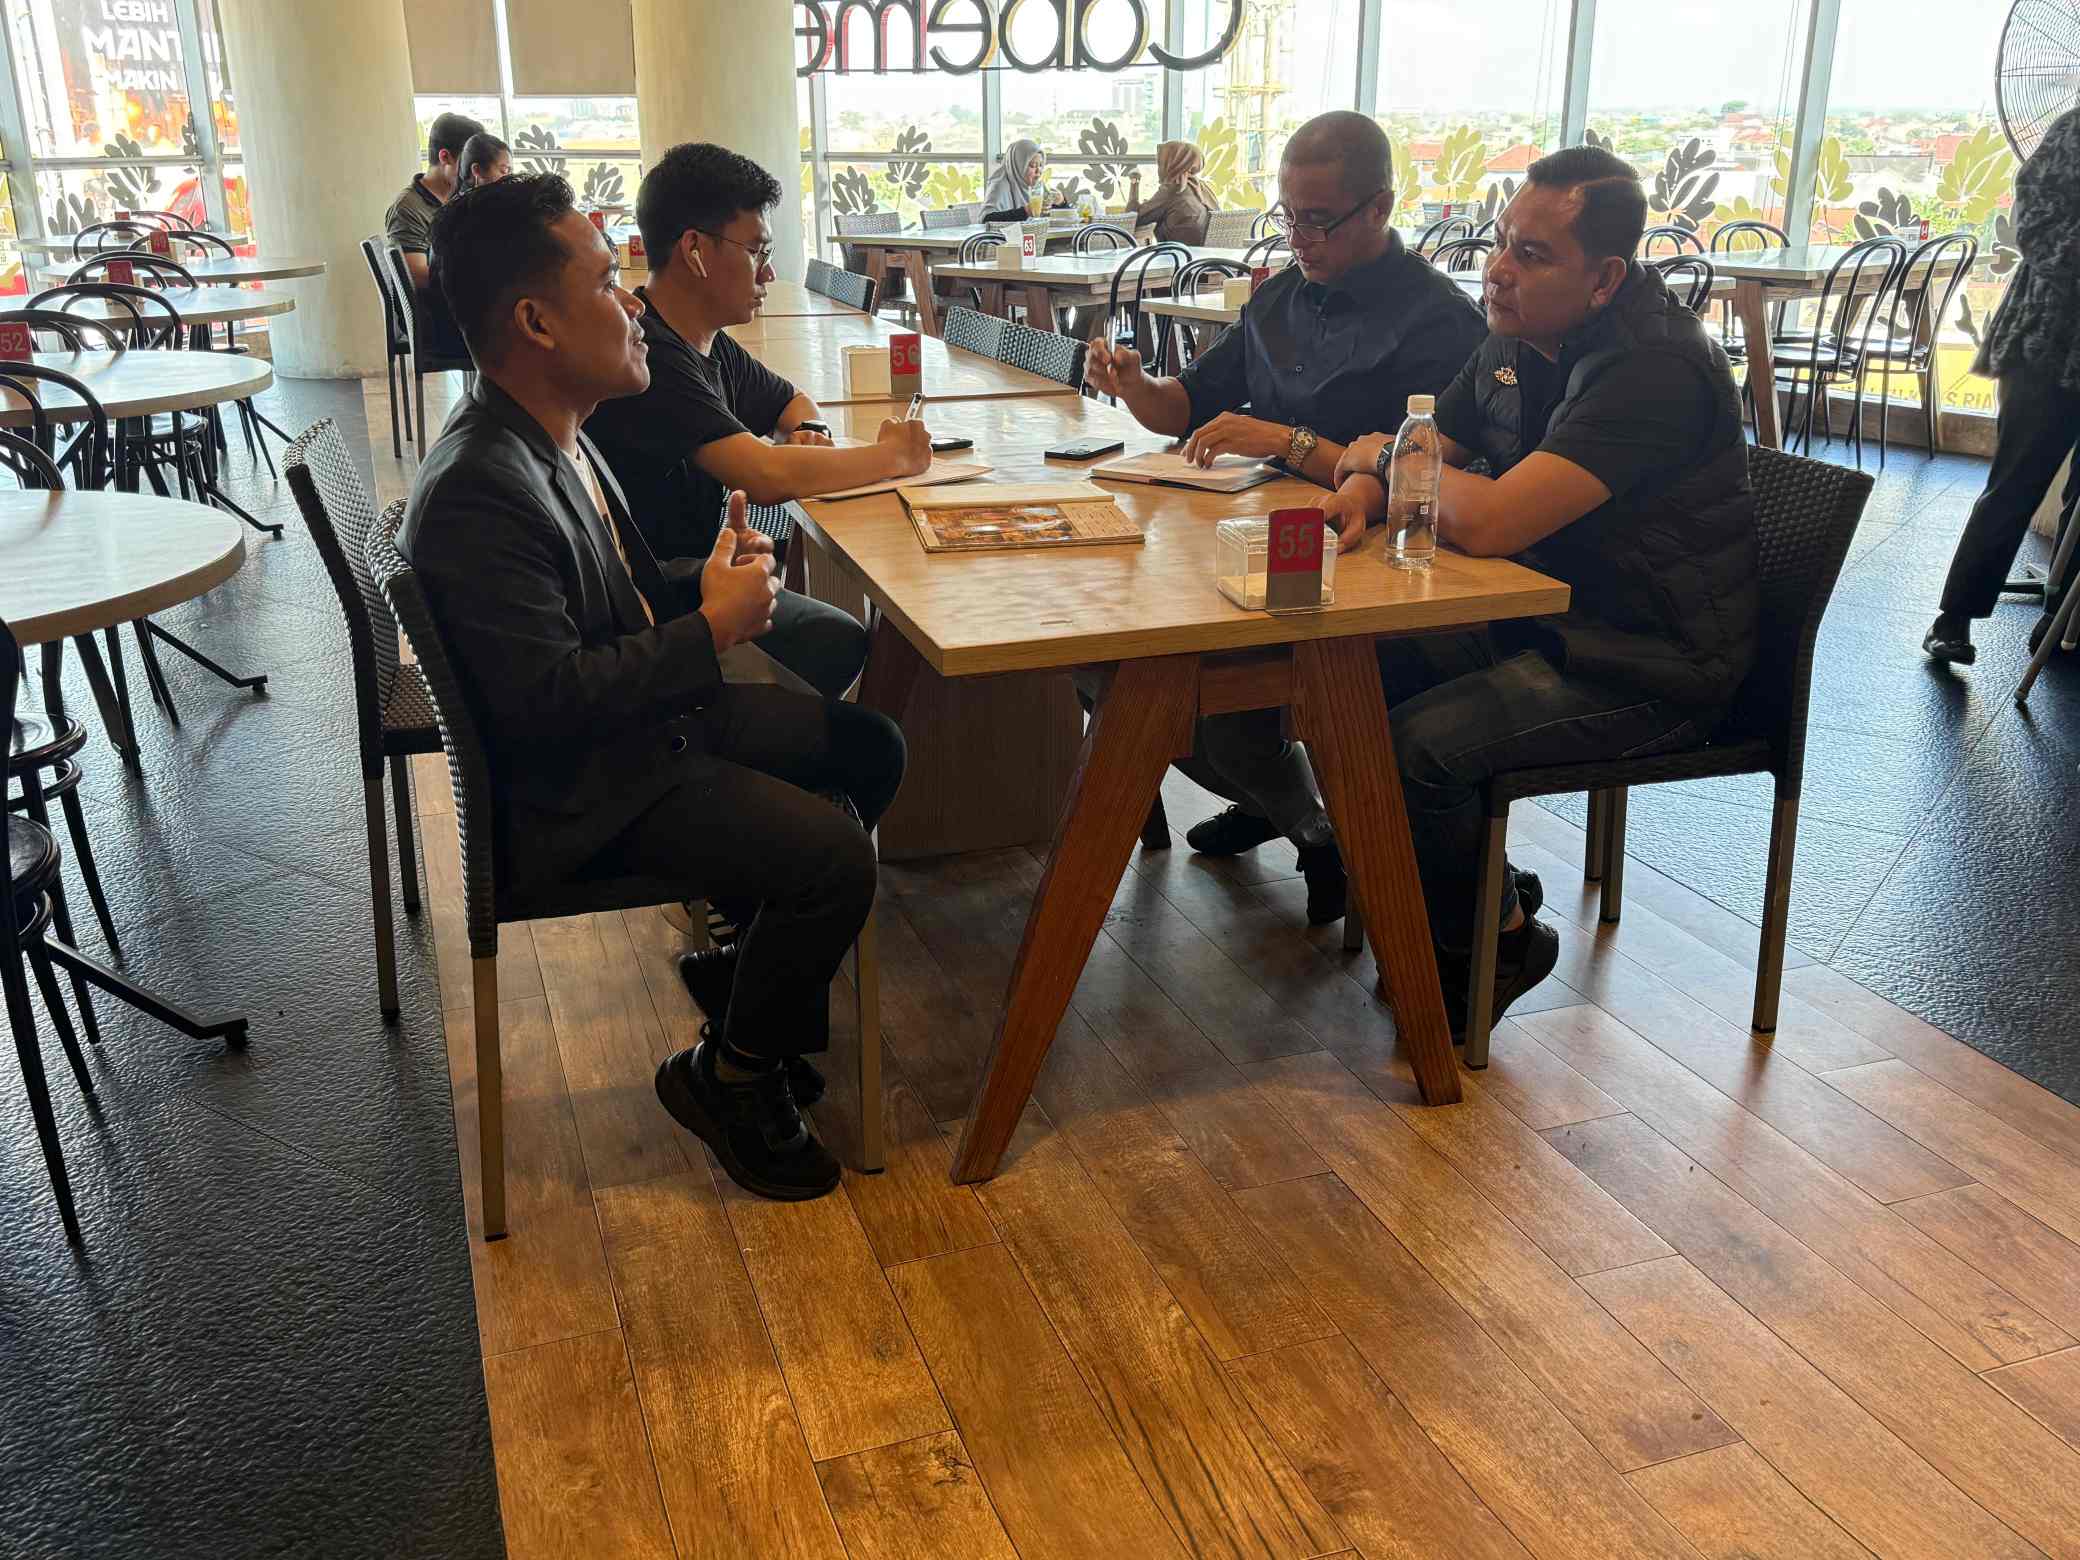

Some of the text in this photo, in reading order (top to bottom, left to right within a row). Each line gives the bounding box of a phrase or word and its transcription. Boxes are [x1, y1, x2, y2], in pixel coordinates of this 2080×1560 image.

[101, 0, 169, 23] LEBIH
[1024, 239, 1033, 252] 63
[0, 332, 23, 352] 52
[1279, 523, 1314, 559] 55
